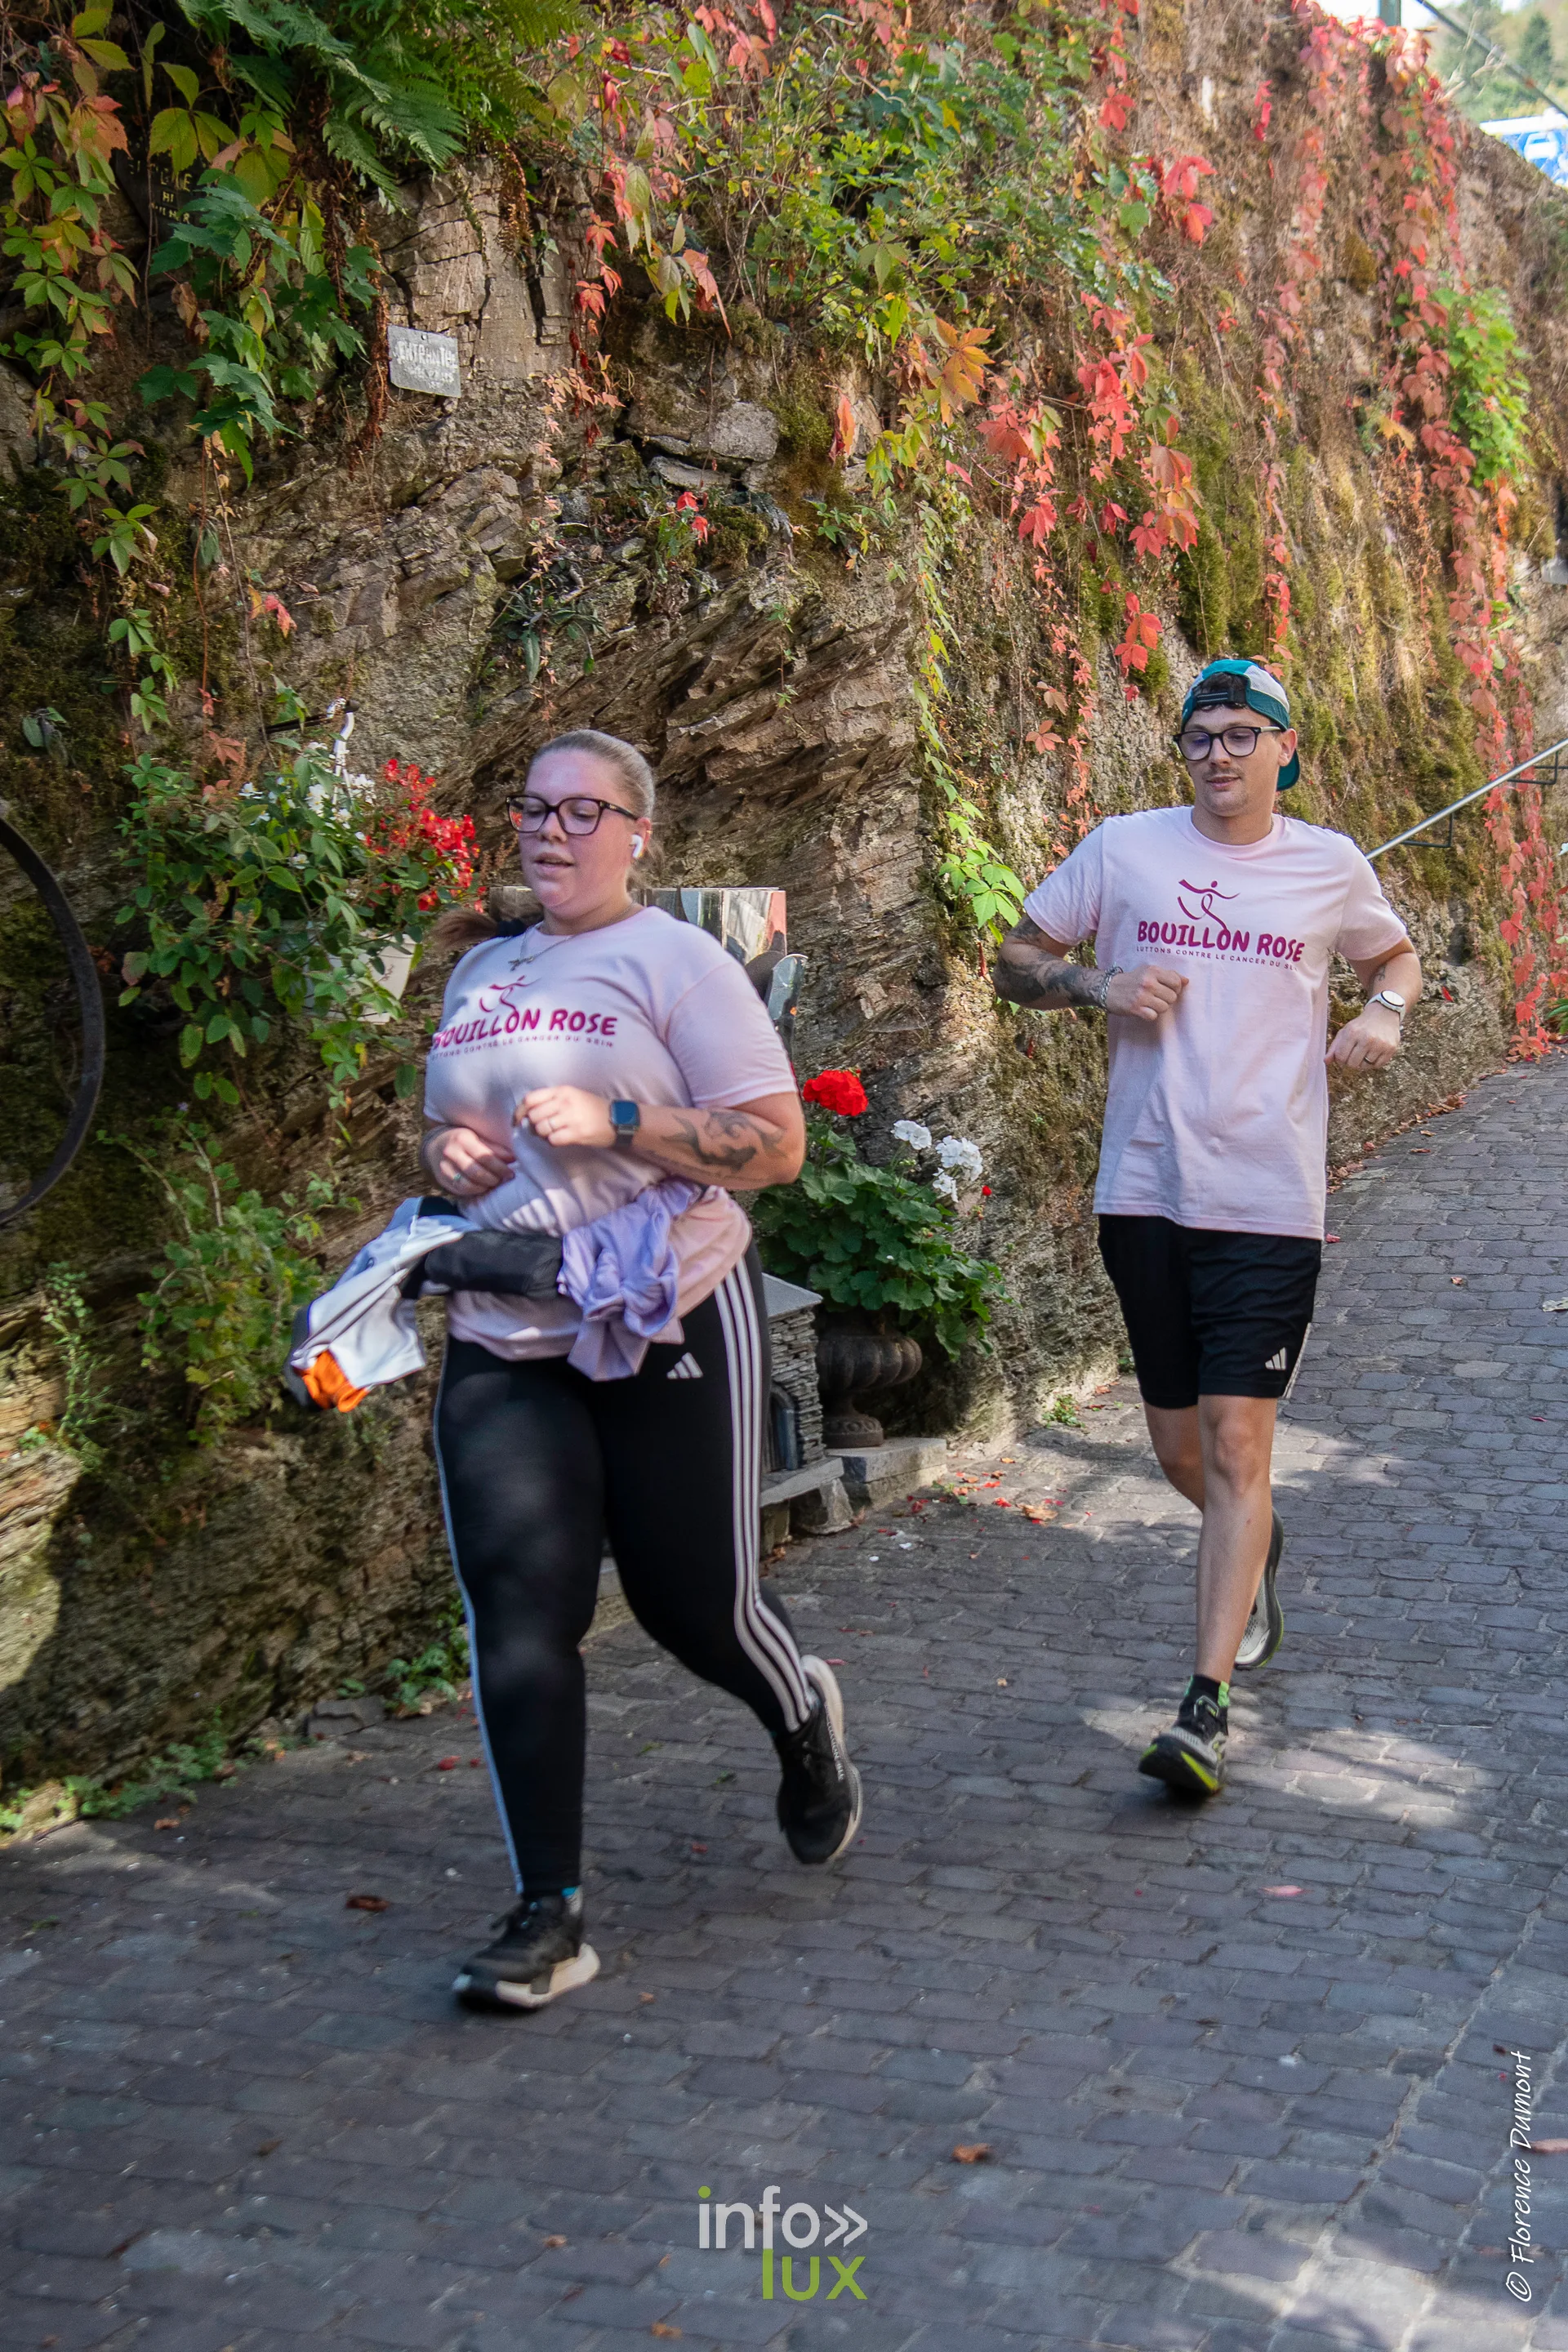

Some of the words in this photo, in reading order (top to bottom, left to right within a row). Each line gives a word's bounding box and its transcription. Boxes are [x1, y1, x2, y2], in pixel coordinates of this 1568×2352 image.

[1136, 946, 1172, 954] LUTTONS
[1176, 949, 1211, 959] CONTRE
[1229, 956, 1266, 964] CANCER
[1138, 920, 1250, 952] BOUILLON
[1256, 933, 1305, 962] ROSE
[549, 1008, 617, 1036] ROSE
